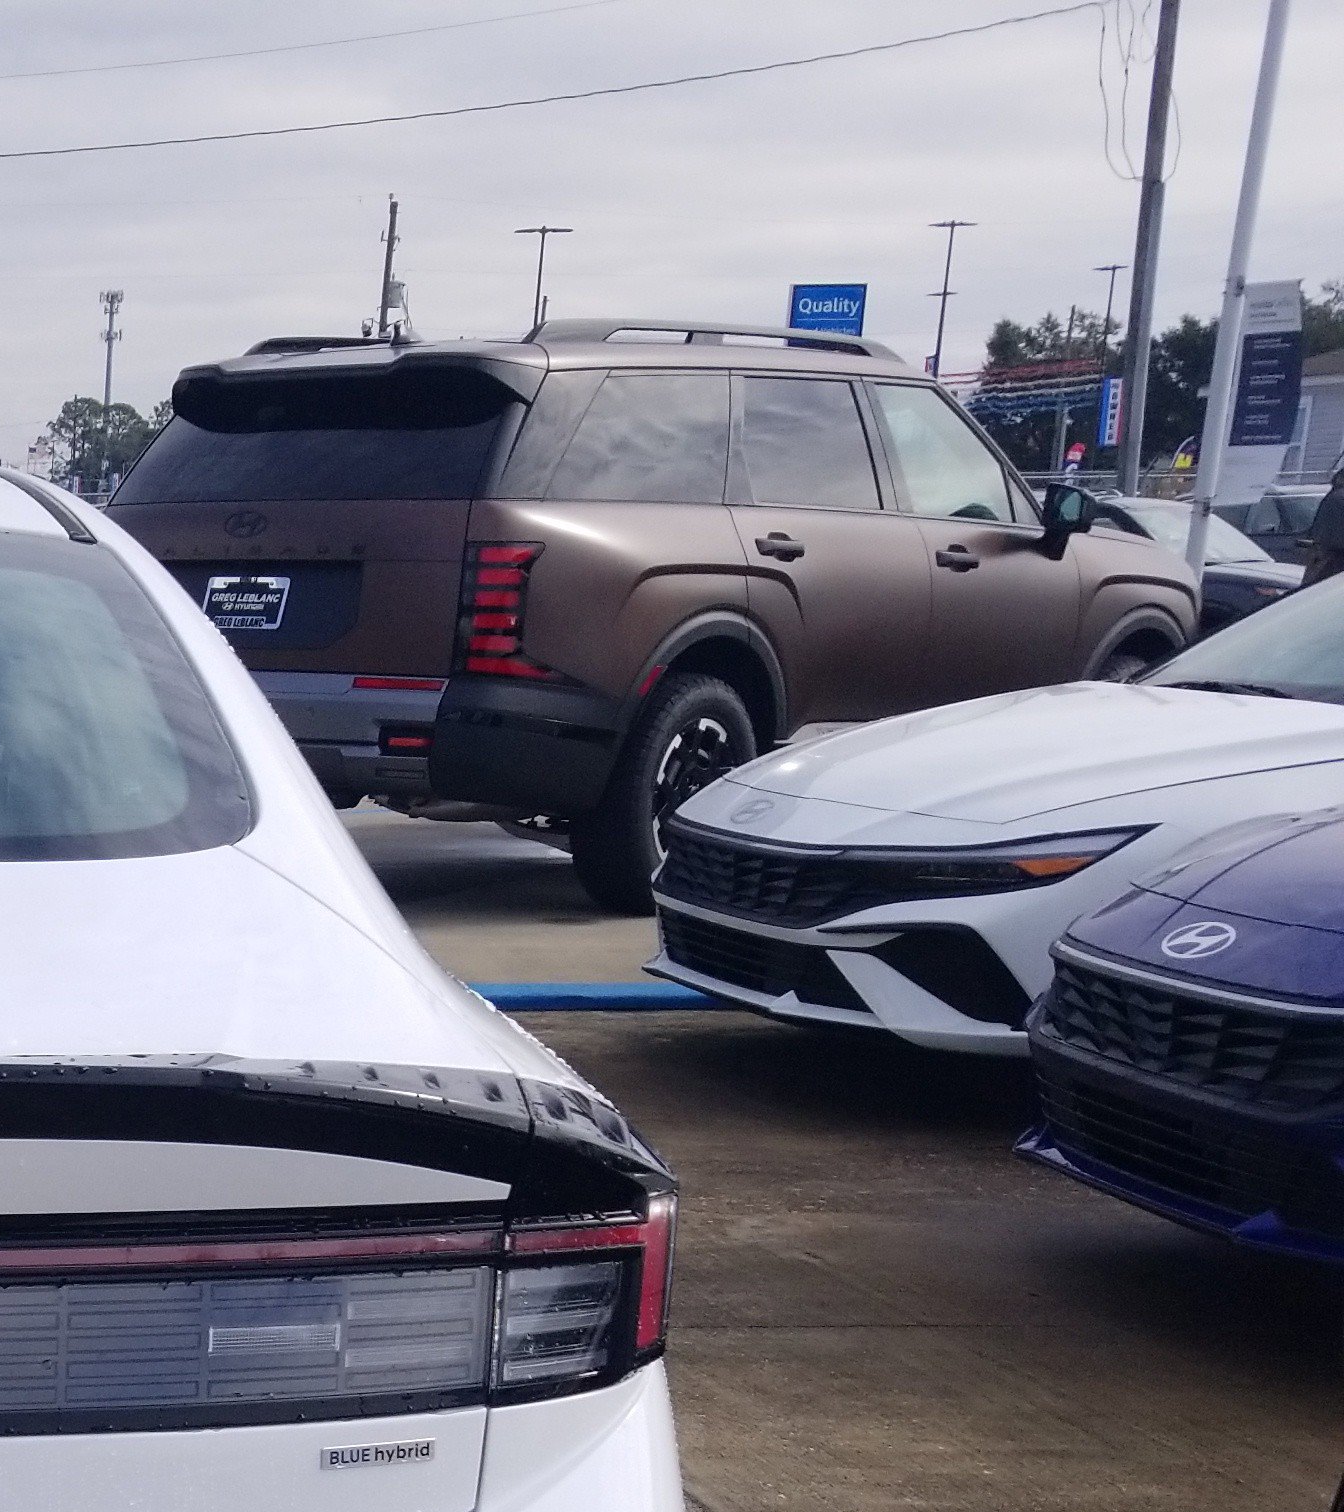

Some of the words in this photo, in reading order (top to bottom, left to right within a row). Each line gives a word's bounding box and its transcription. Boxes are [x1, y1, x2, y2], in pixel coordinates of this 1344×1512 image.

[798, 297, 860, 317] Quality
[212, 593, 236, 602] GREG
[237, 593, 280, 603] LEBLANC
[329, 1448, 371, 1465] BLUE
[374, 1442, 430, 1463] hybrid
